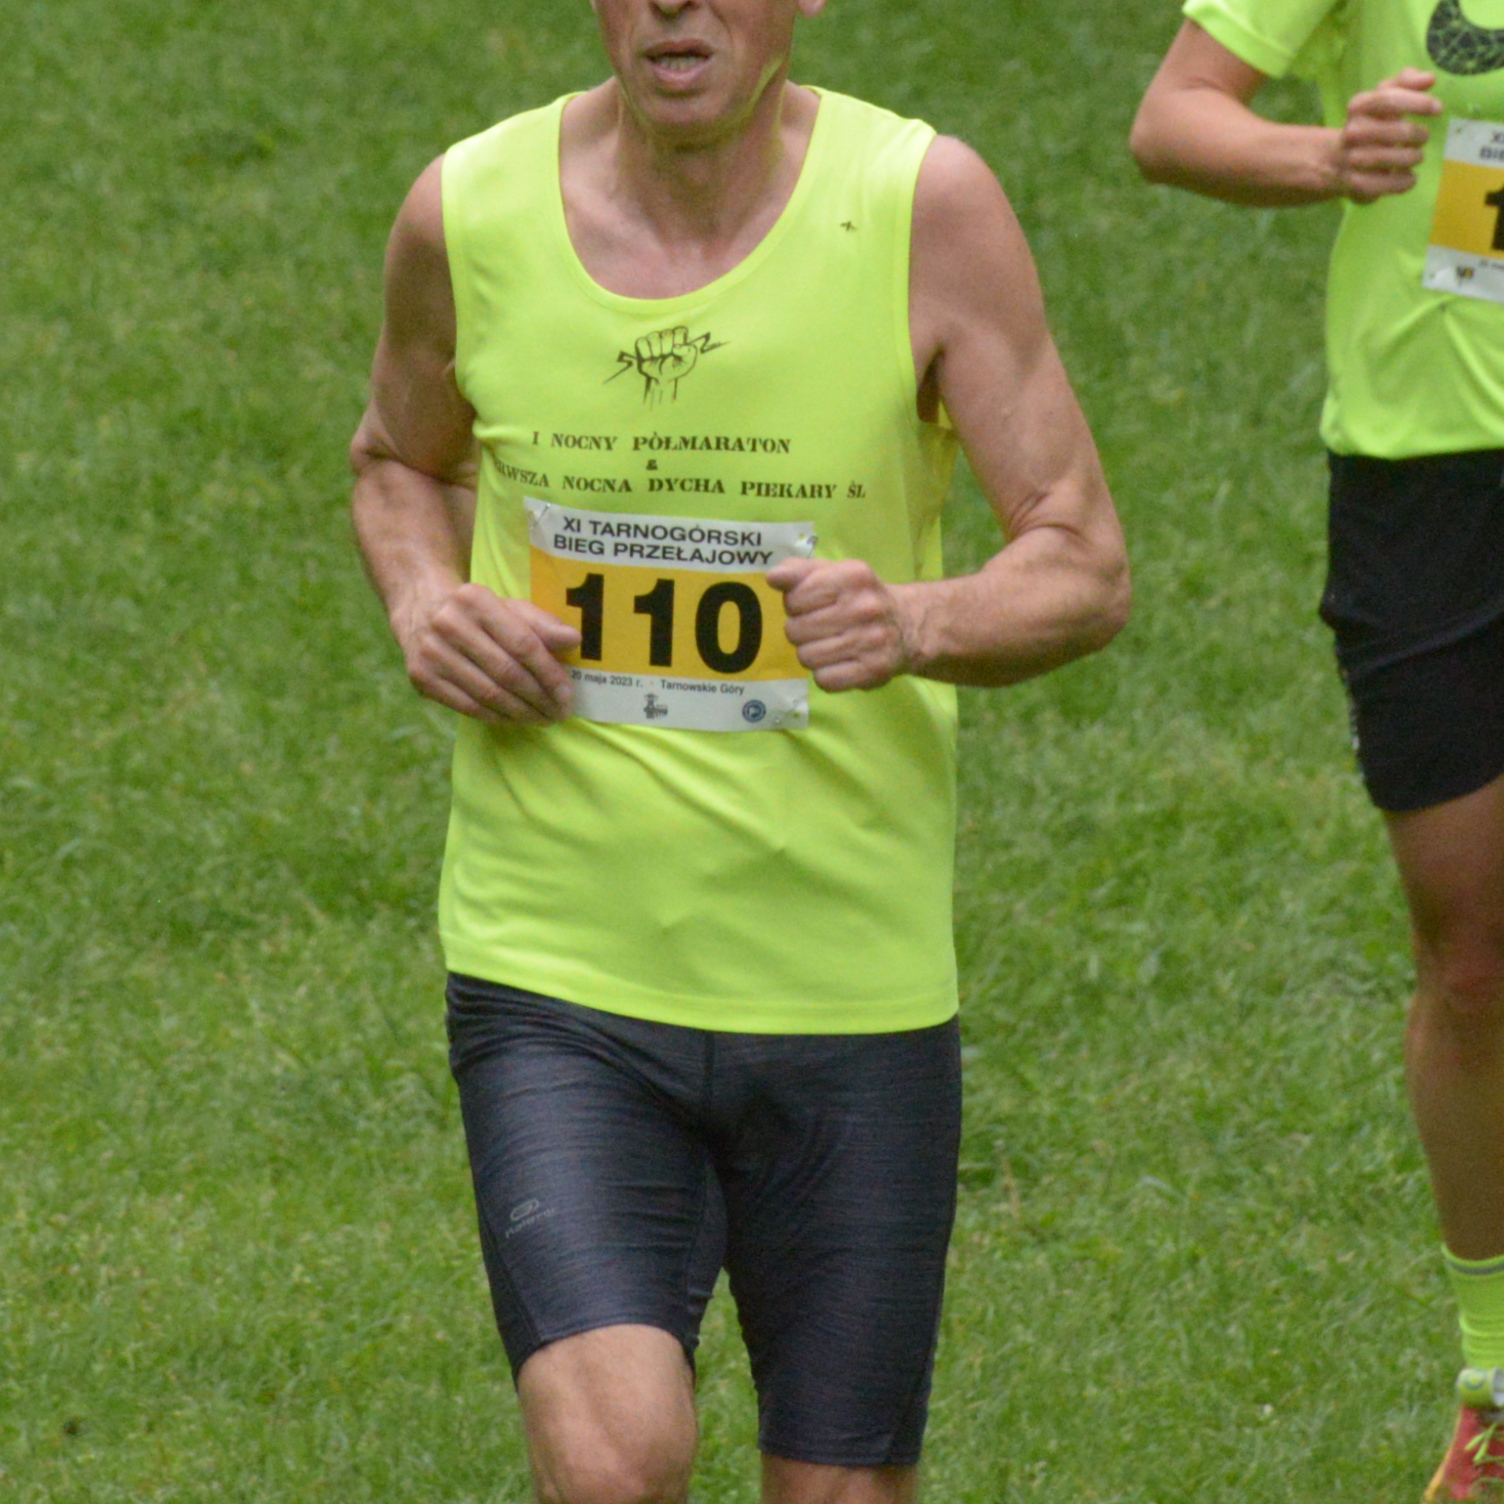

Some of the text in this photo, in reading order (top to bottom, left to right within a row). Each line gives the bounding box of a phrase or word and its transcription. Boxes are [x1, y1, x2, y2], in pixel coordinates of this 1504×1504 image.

[532, 431, 539, 445] I
[552, 433, 618, 451] NOCNY
[646, 459, 658, 471] &
[562, 475, 633, 493] NOCNA
[648, 477, 726, 494] DYCHA
[740, 481, 837, 499] PIEKARY
[563, 517, 762, 547] XI TARNOGÓRSKI
[553, 534, 774, 566] BIEG PRZEŁAJOWY
[566, 573, 764, 674] 110
[584, 673, 607, 685] maja
[610, 676, 633, 687] 2023
[661, 679, 717, 693] Tarnowskie
[720, 683, 745, 696] Góry
